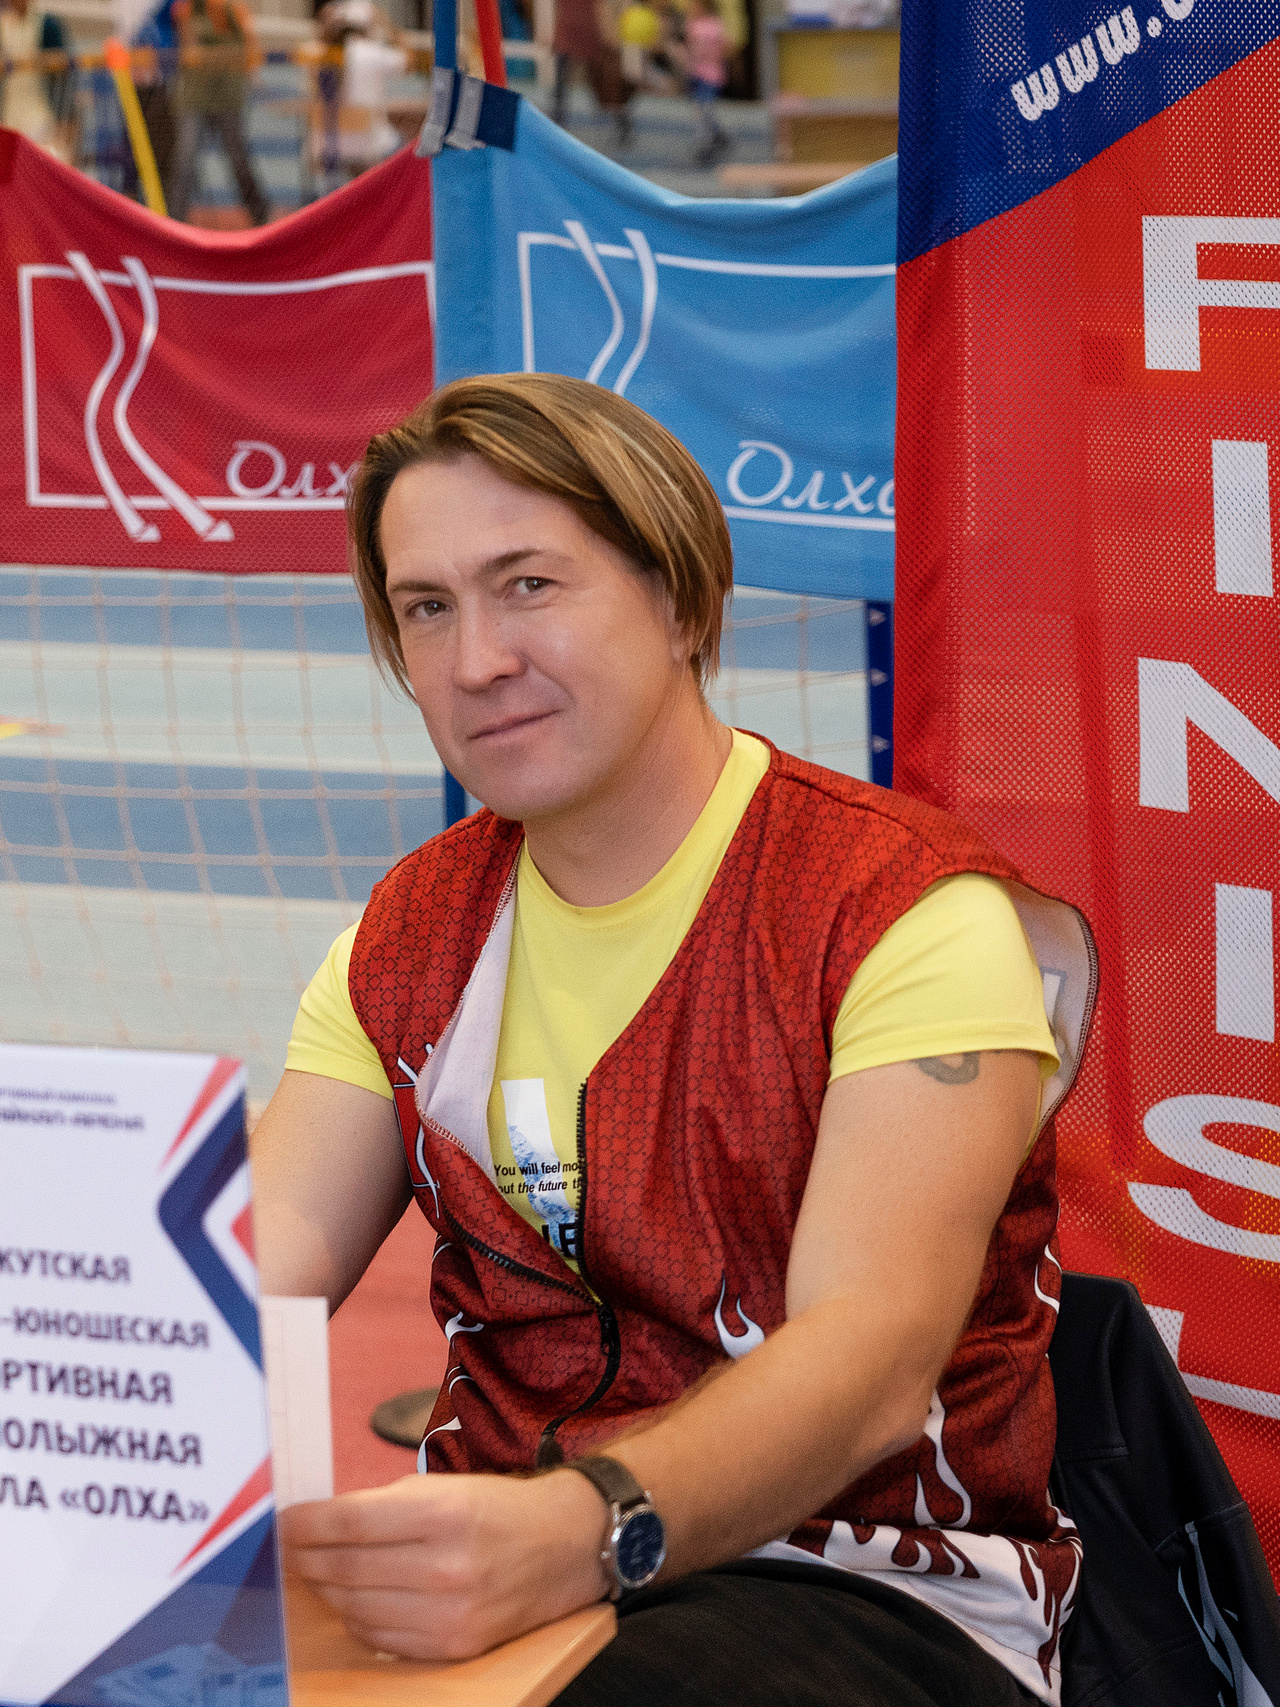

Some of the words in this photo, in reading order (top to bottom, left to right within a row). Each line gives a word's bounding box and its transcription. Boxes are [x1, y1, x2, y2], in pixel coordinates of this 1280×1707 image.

[494, 1165, 516, 1177] You
[518, 1162, 538, 1175] will
[540, 1161, 560, 1174] feel
[518, 1182, 535, 1194] the
[538, 1180, 568, 1192] future
[60, 1483, 211, 1525] «ОЛХА»
